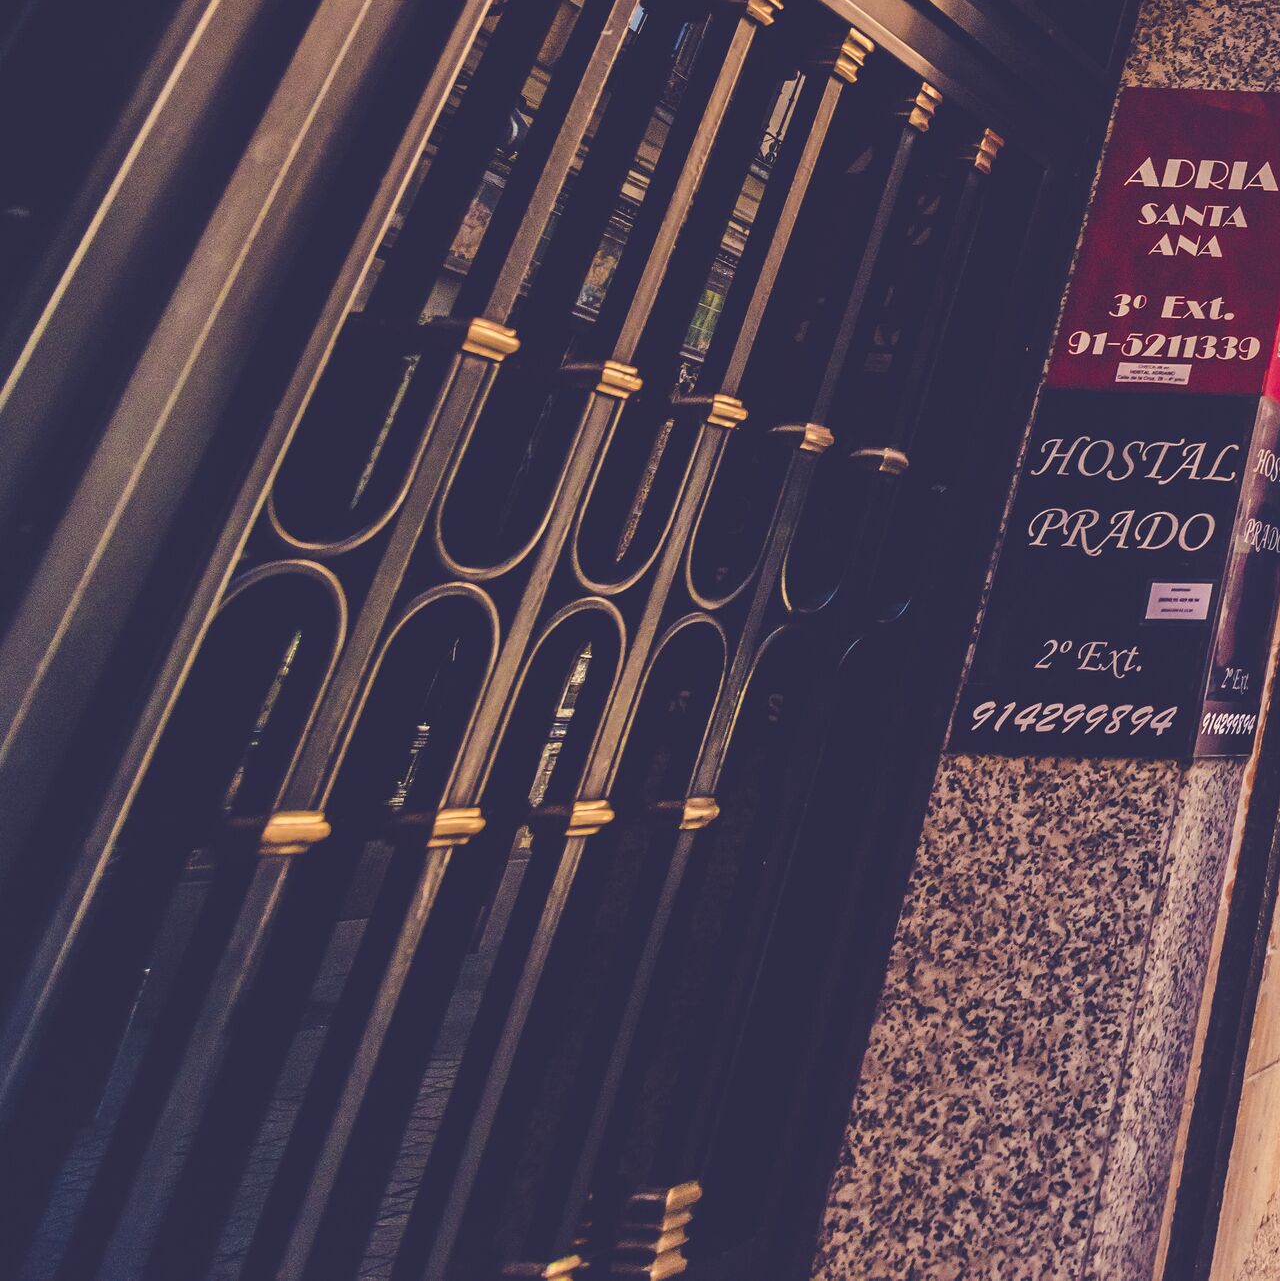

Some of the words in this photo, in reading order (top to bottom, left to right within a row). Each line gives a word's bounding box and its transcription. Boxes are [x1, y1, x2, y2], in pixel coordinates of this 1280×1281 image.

[1123, 156, 1279, 192] ADRIA
[1137, 202, 1248, 228] SANTA
[1147, 233, 1223, 258] ANA
[1160, 295, 1236, 321] Ext.
[1067, 329, 1261, 362] 91-5211339
[1030, 435, 1240, 485] HOSTAL
[1028, 508, 1216, 557] PRADO
[1077, 640, 1142, 679] Ext.
[1232, 668, 1249, 695] Ext.
[970, 698, 1178, 737] 914299894
[1200, 712, 1256, 735] 914299894
